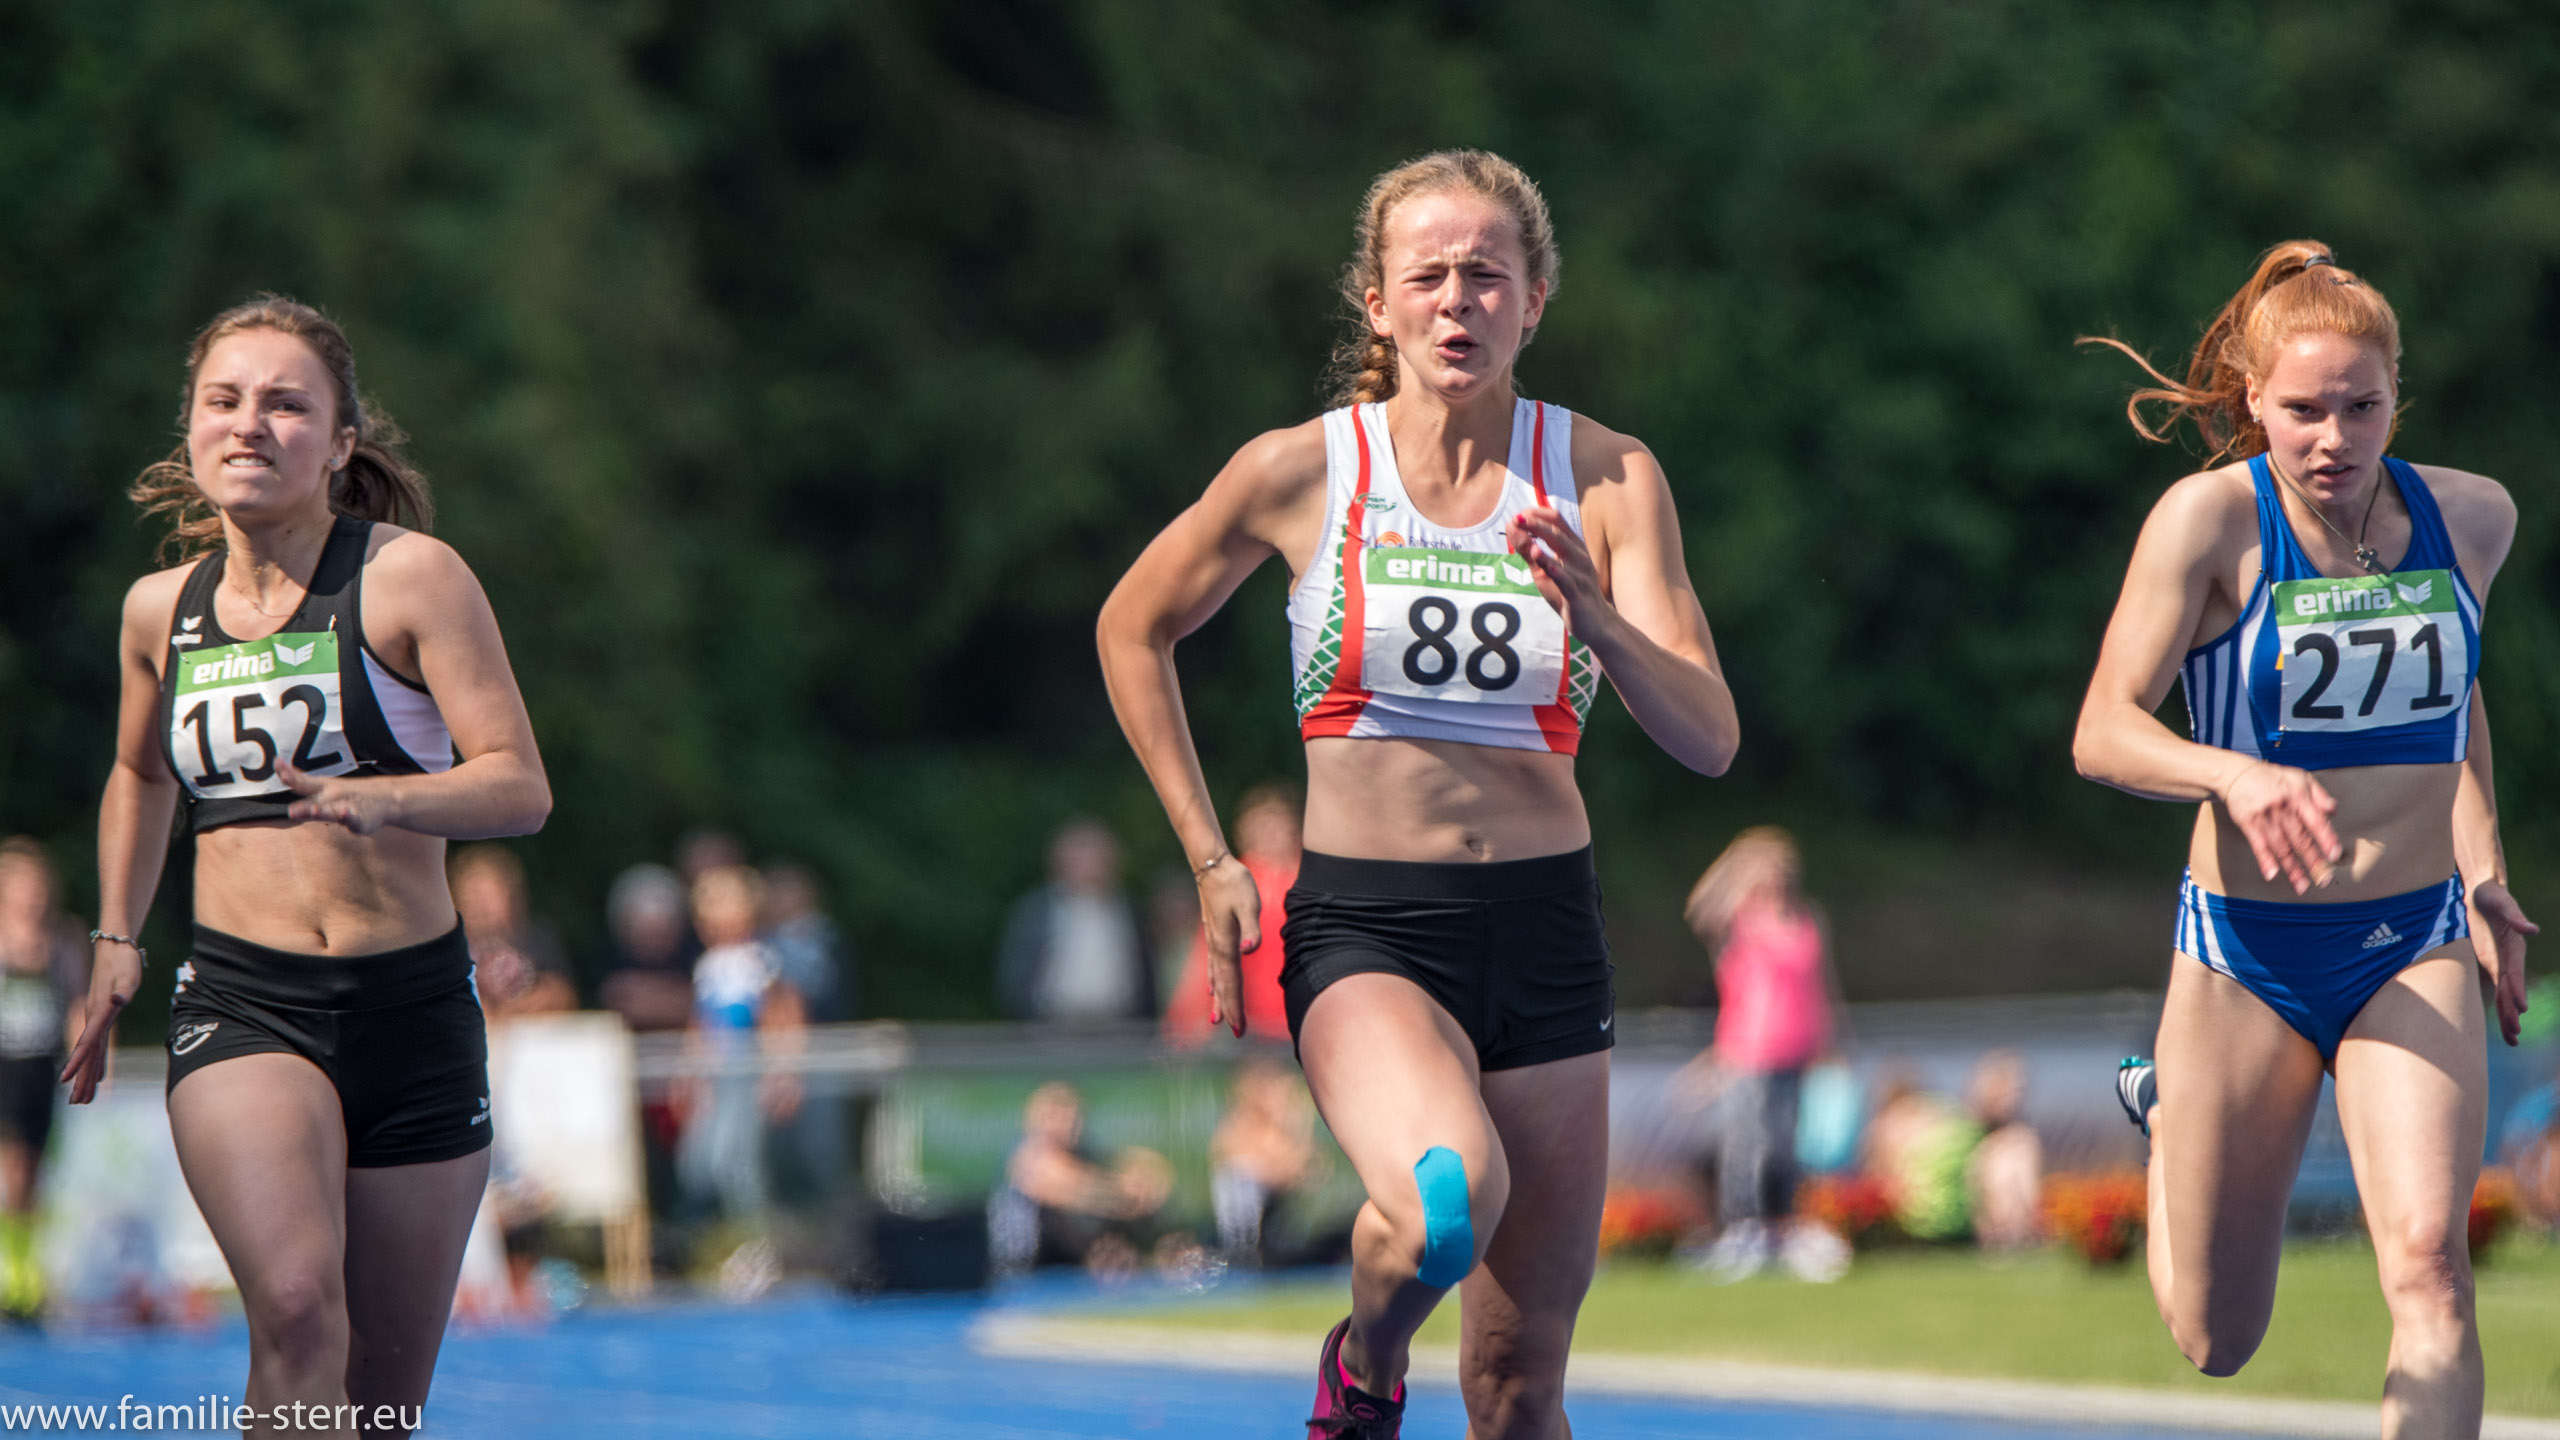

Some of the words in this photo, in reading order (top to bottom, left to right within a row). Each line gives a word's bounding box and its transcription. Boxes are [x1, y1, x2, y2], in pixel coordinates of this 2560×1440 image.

[1387, 555, 1497, 586] erima
[2294, 585, 2392, 616] erima
[1402, 596, 1521, 691] 88
[192, 650, 275, 685] erima
[2291, 622, 2454, 719] 271
[183, 684, 343, 787] 152
[2362, 934, 2402, 948] adidas
